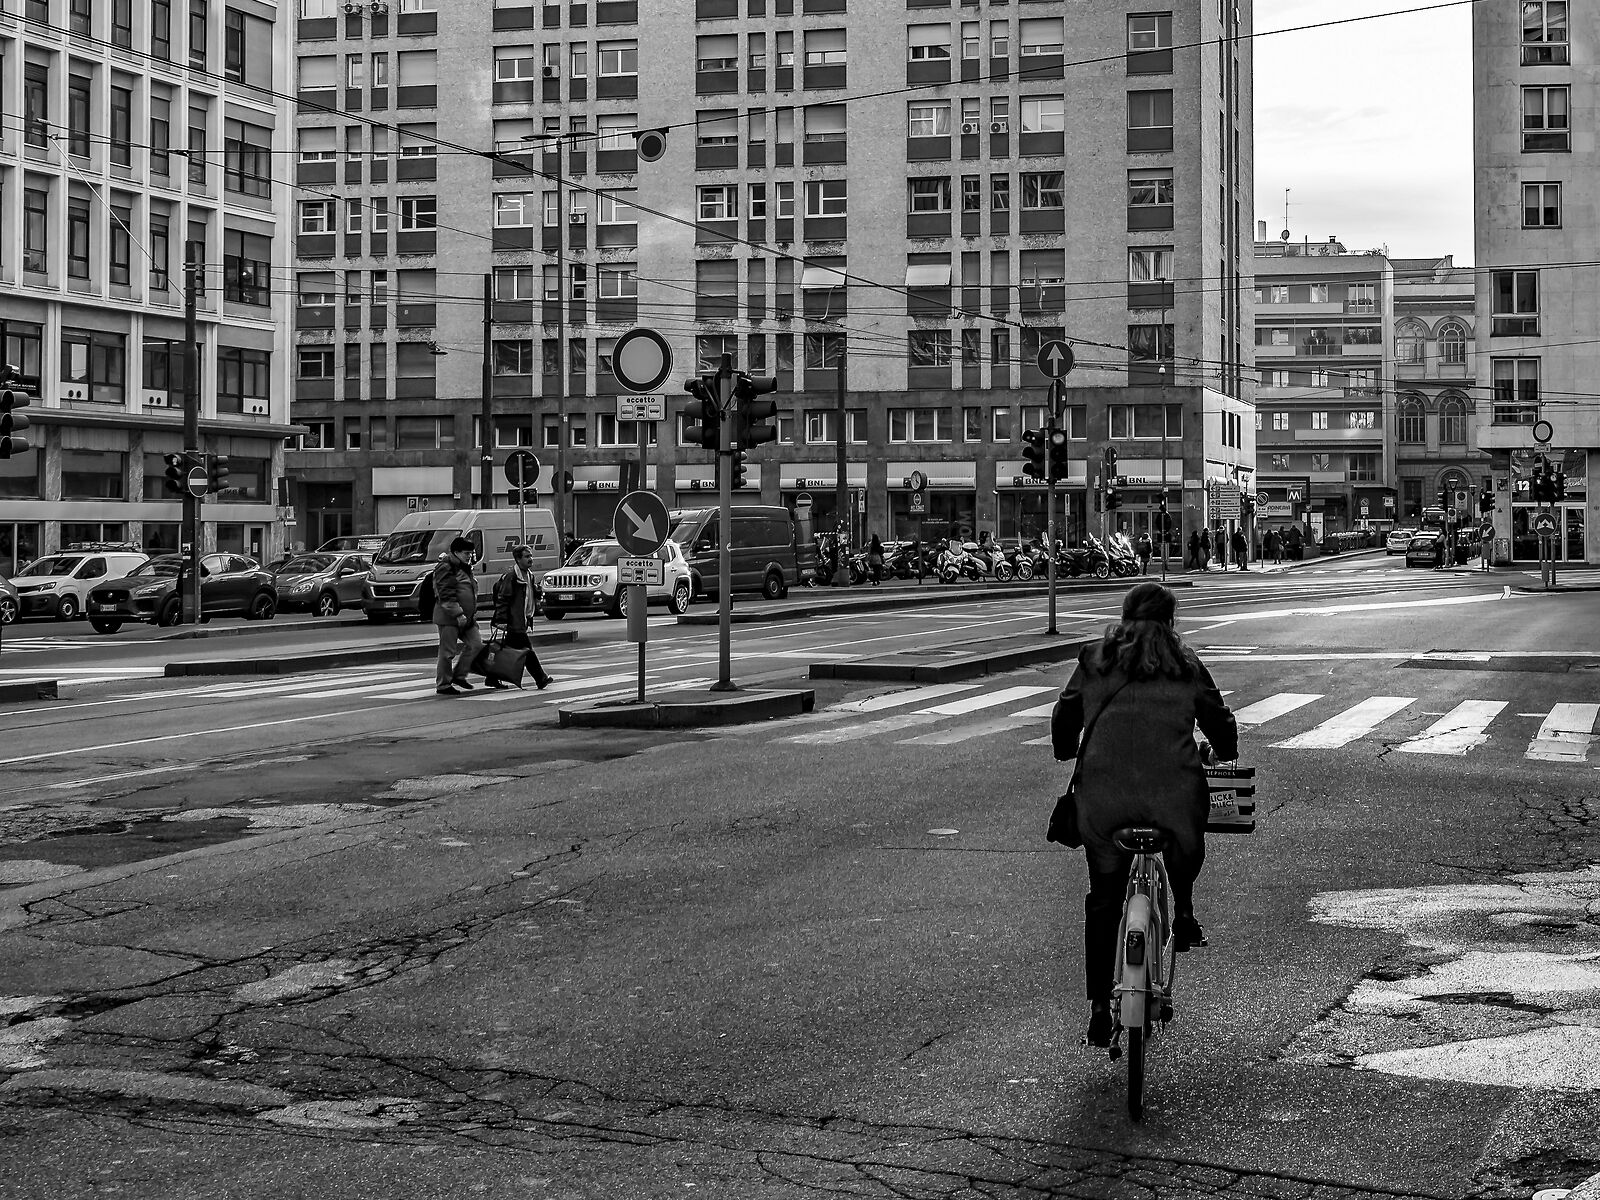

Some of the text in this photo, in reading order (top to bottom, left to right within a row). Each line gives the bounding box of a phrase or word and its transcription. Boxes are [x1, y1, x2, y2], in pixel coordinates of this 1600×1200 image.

[1517, 480, 1530, 491] 12
[1288, 491, 1300, 500] M
[1210, 793, 1234, 802] LICK&
[1210, 800, 1234, 809] OLLECT
